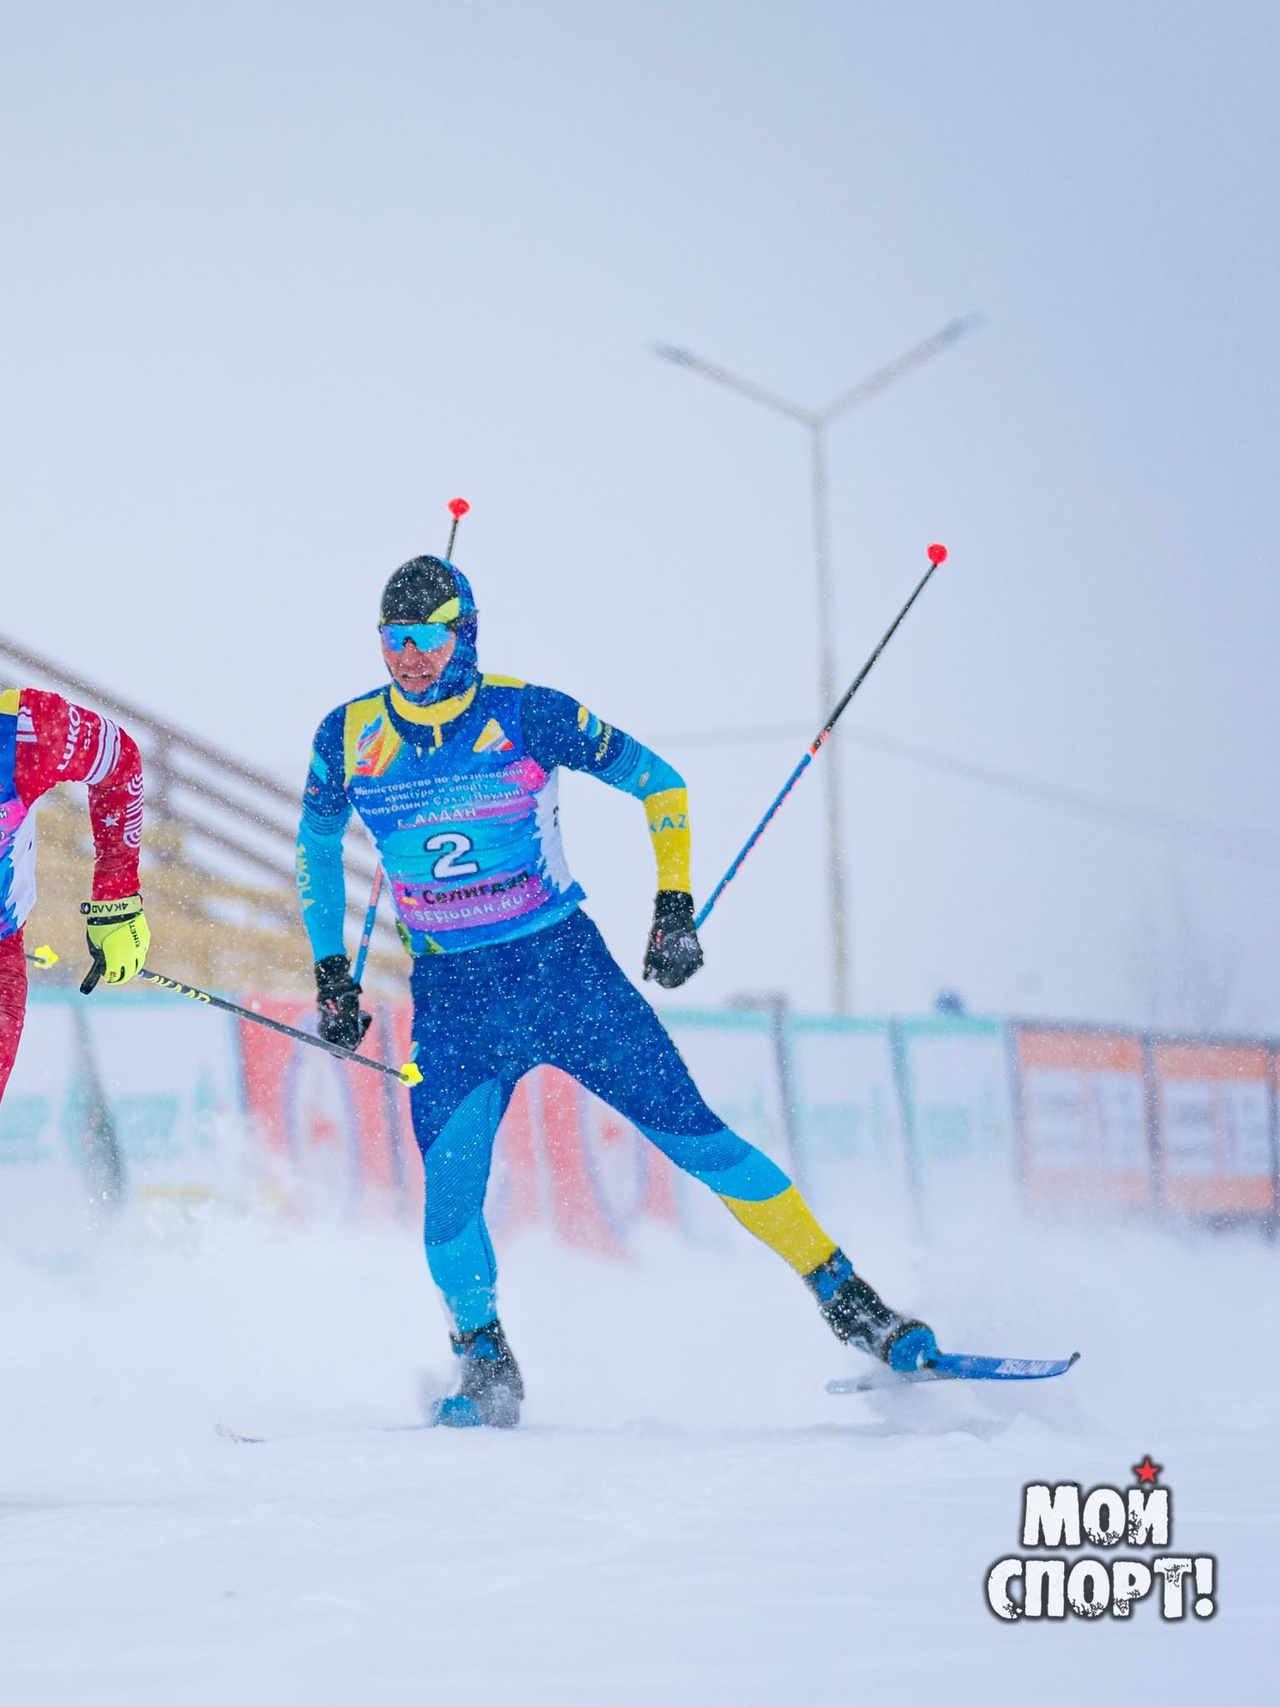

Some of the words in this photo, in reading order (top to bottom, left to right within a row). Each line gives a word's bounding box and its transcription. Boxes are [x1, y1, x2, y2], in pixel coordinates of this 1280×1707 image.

[414, 807, 478, 825] АЛДАН
[425, 832, 480, 881] 2
[422, 869, 530, 905] Селигдар
[413, 893, 525, 923] SELIGDAR.RU
